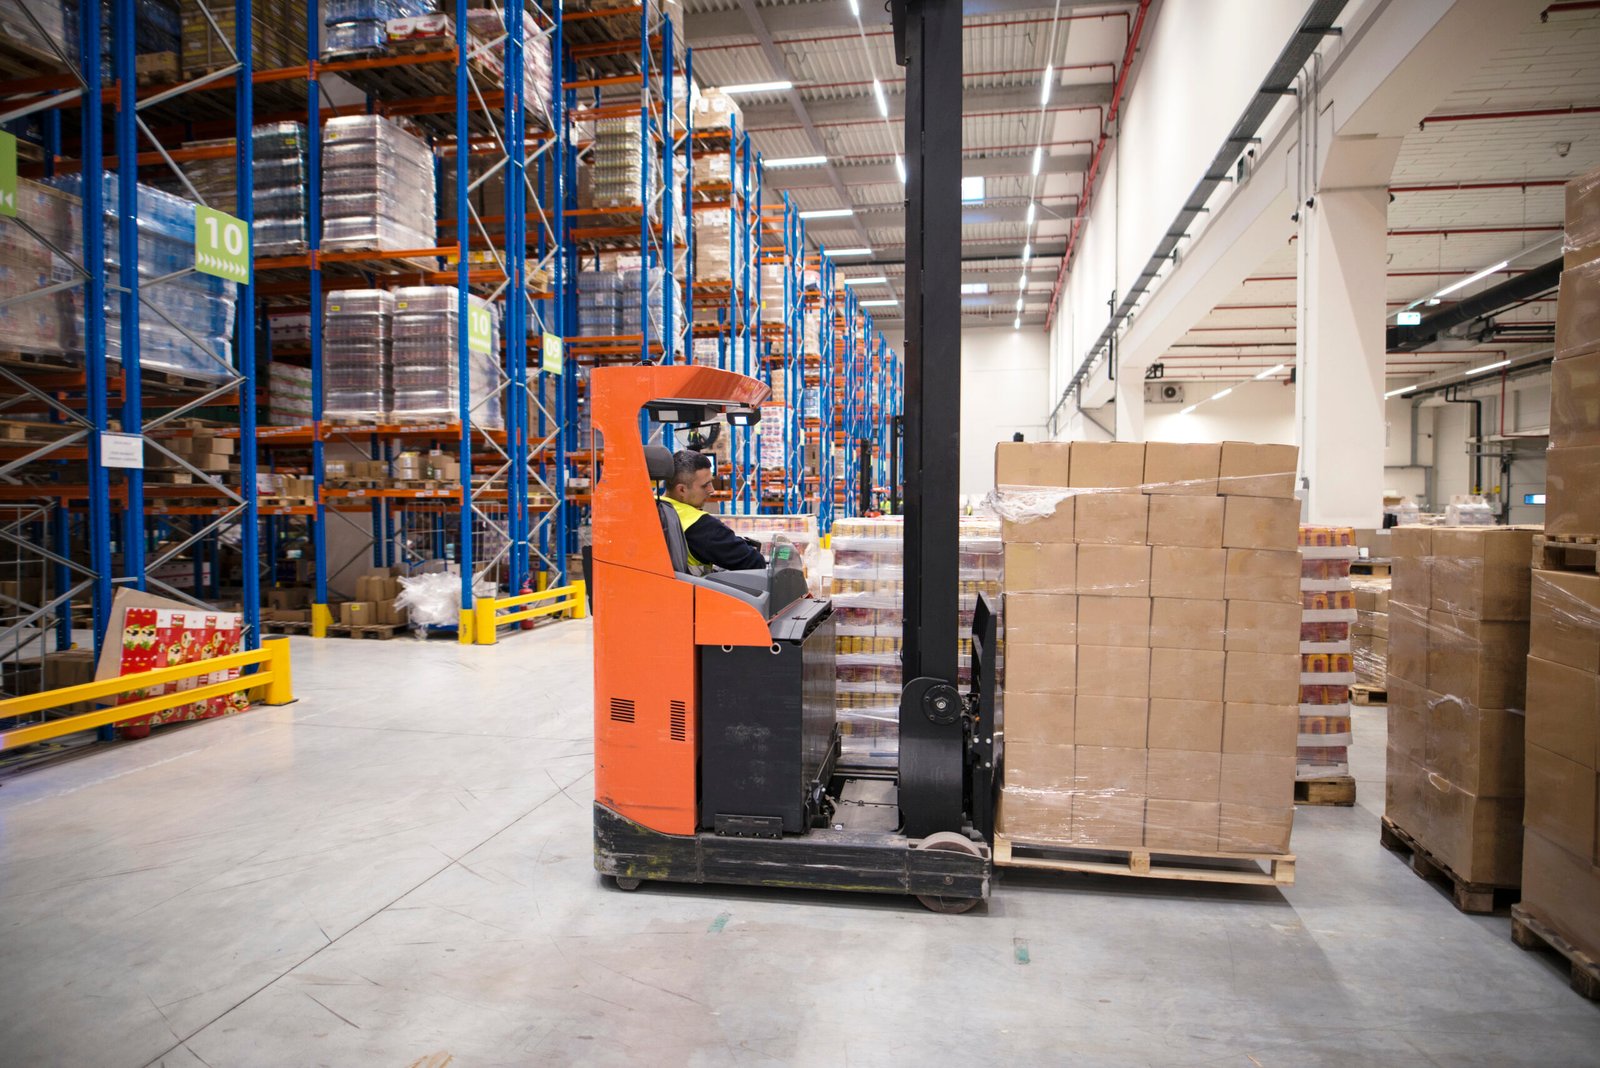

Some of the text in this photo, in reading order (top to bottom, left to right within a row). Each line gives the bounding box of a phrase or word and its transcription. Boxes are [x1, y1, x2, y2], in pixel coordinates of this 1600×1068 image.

[204, 216, 243, 256] 10
[471, 312, 489, 336] 10
[546, 338, 560, 358] 09
